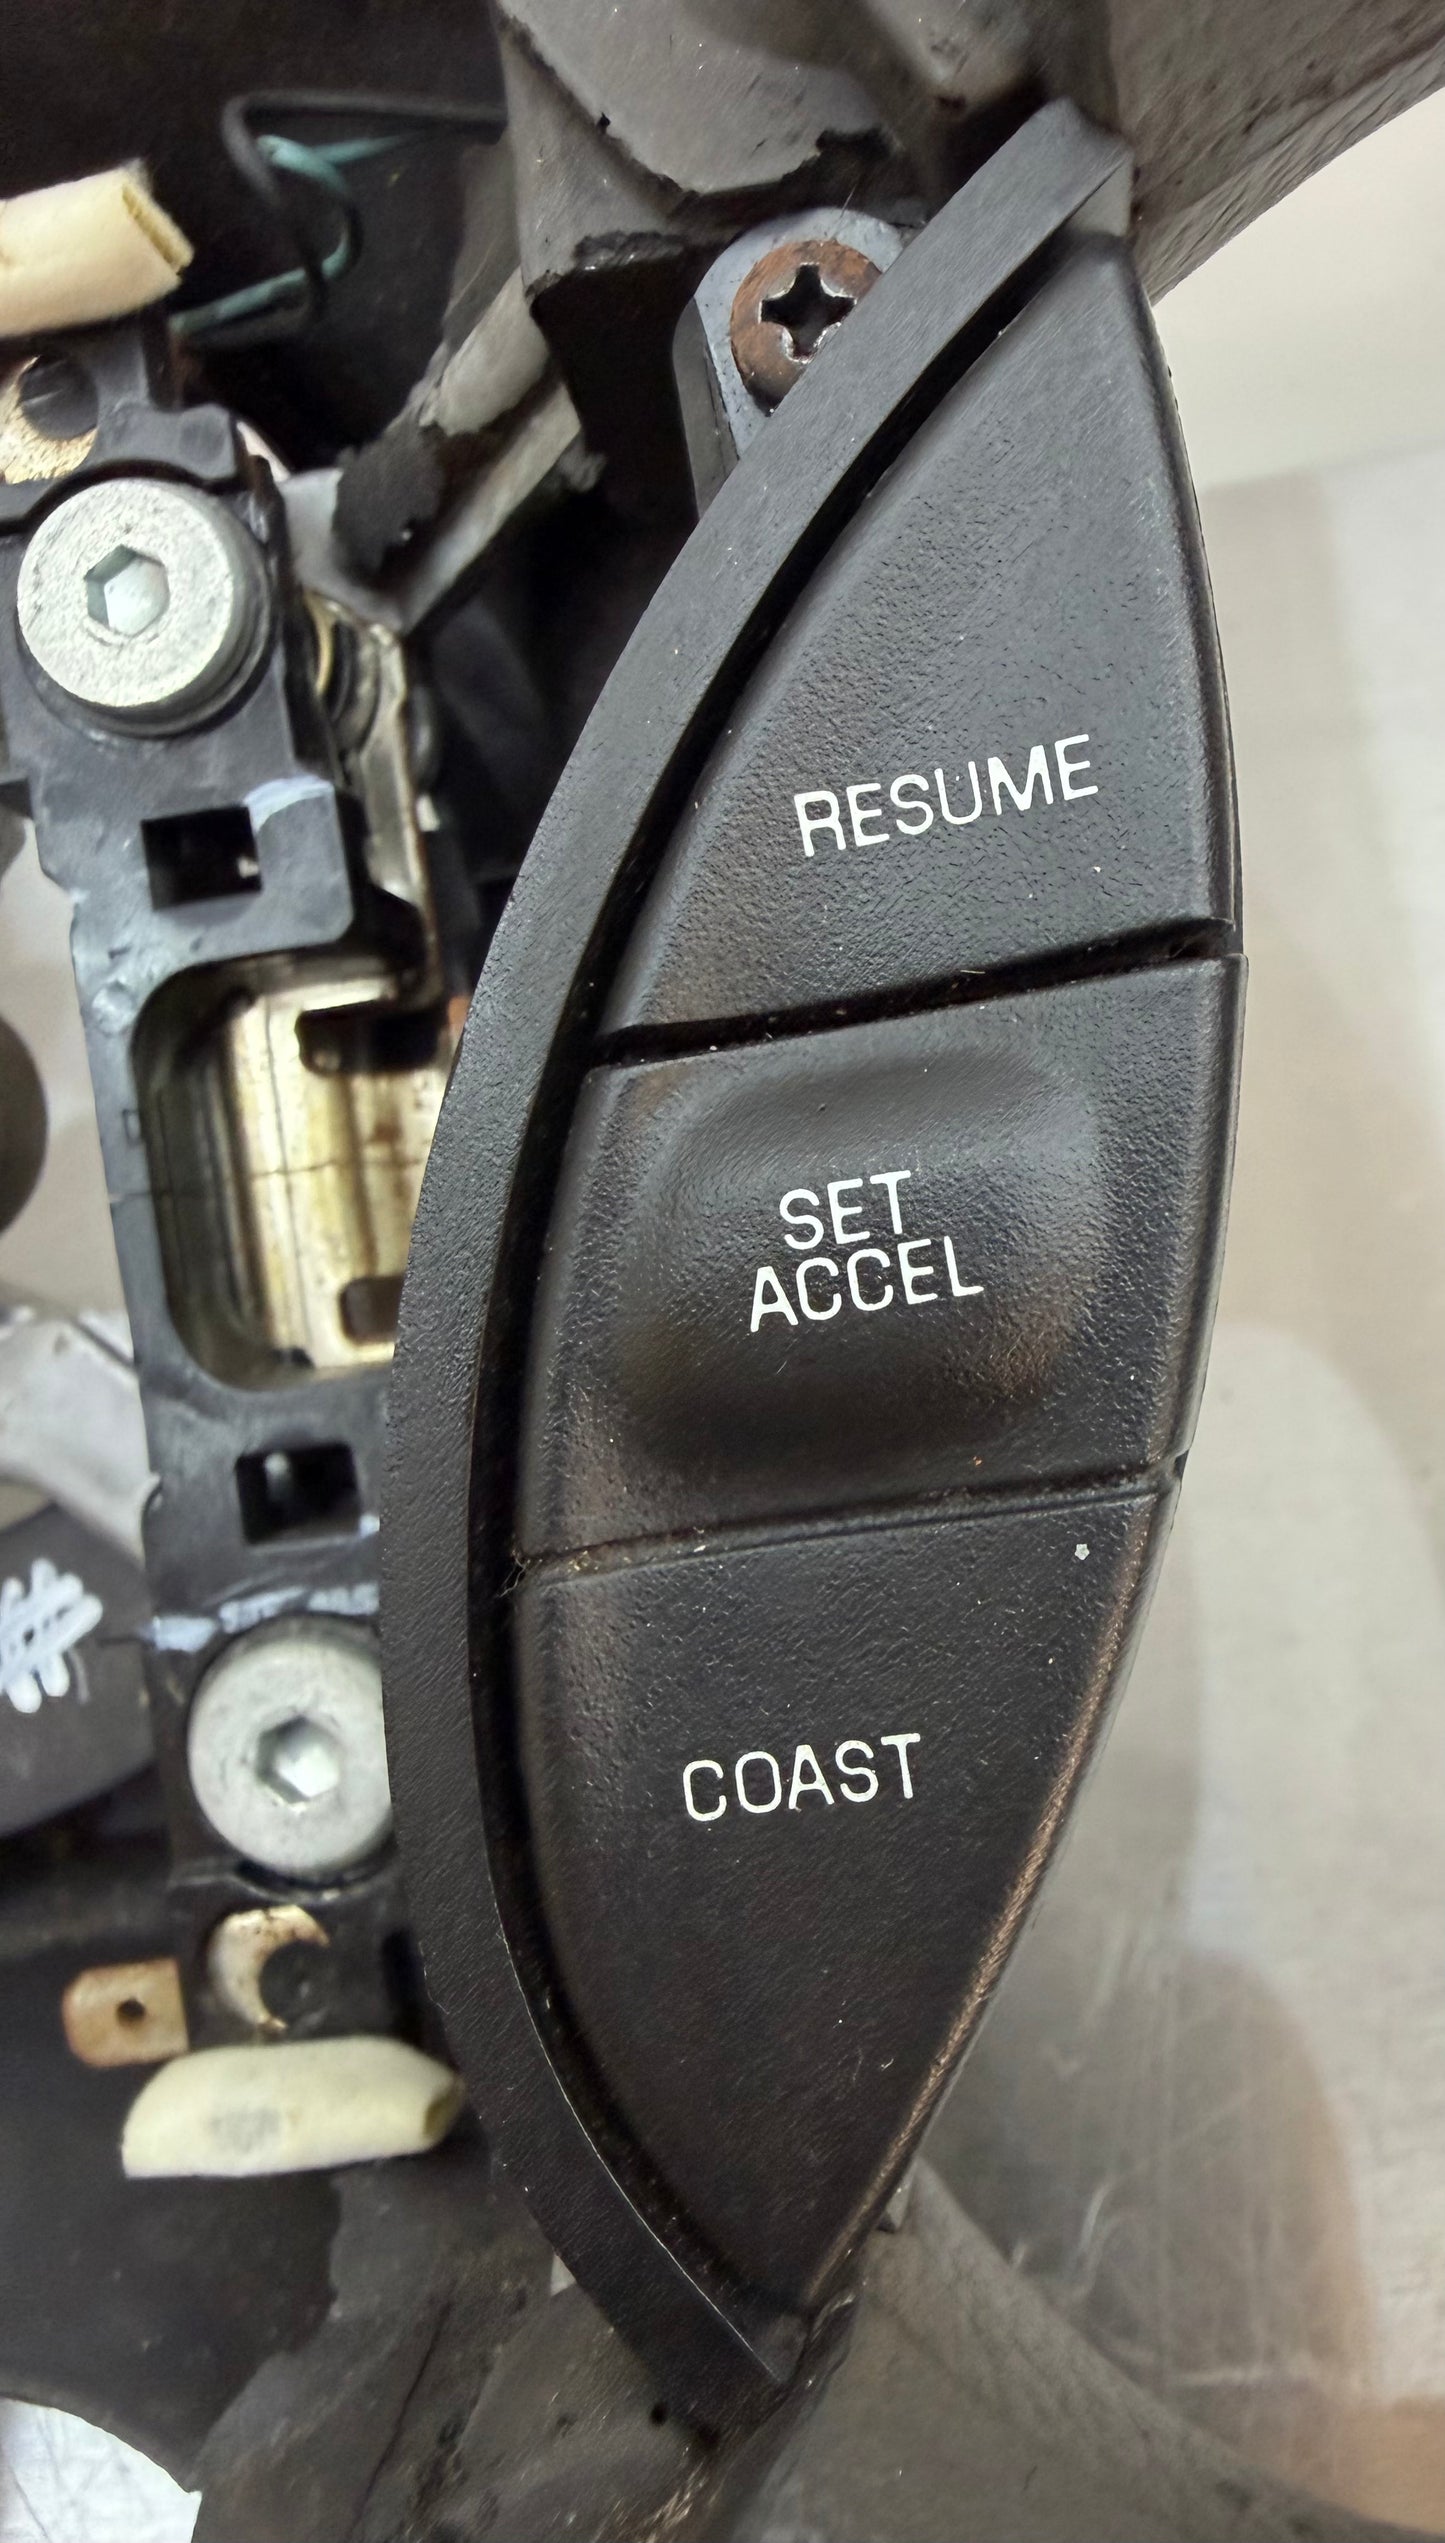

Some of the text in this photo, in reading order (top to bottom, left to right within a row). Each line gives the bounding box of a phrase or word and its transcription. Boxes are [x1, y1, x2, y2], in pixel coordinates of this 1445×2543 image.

[793, 733, 1099, 857] RESUME
[778, 1170, 915, 1251] SET
[749, 1236, 985, 1333] ACCEL
[682, 1733, 921, 1823] COAST
